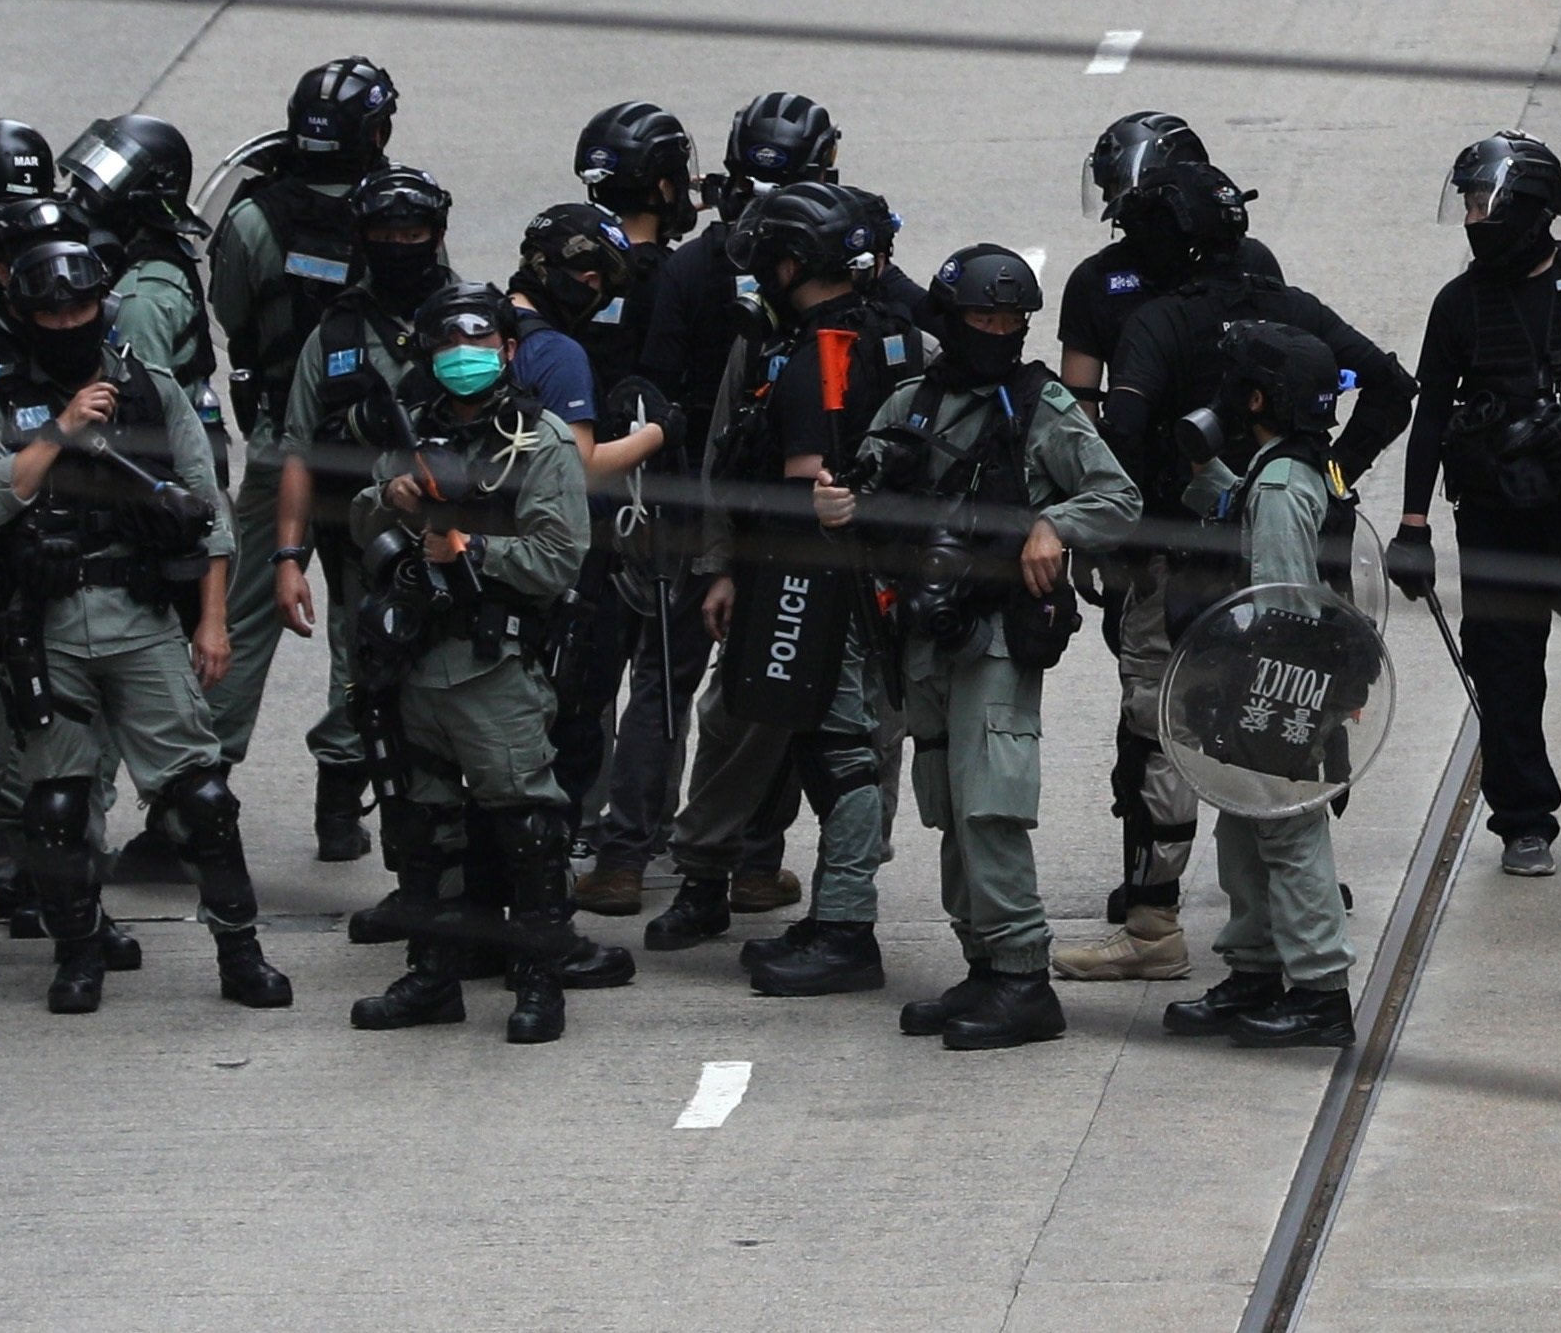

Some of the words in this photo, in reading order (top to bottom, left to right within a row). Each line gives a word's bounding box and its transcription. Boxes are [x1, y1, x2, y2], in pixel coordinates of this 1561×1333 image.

[307, 116, 329, 126] MAR
[766, 575, 810, 681] POLICE
[1249, 656, 1333, 712] POLICE
[1239, 696, 1316, 745] 警察
